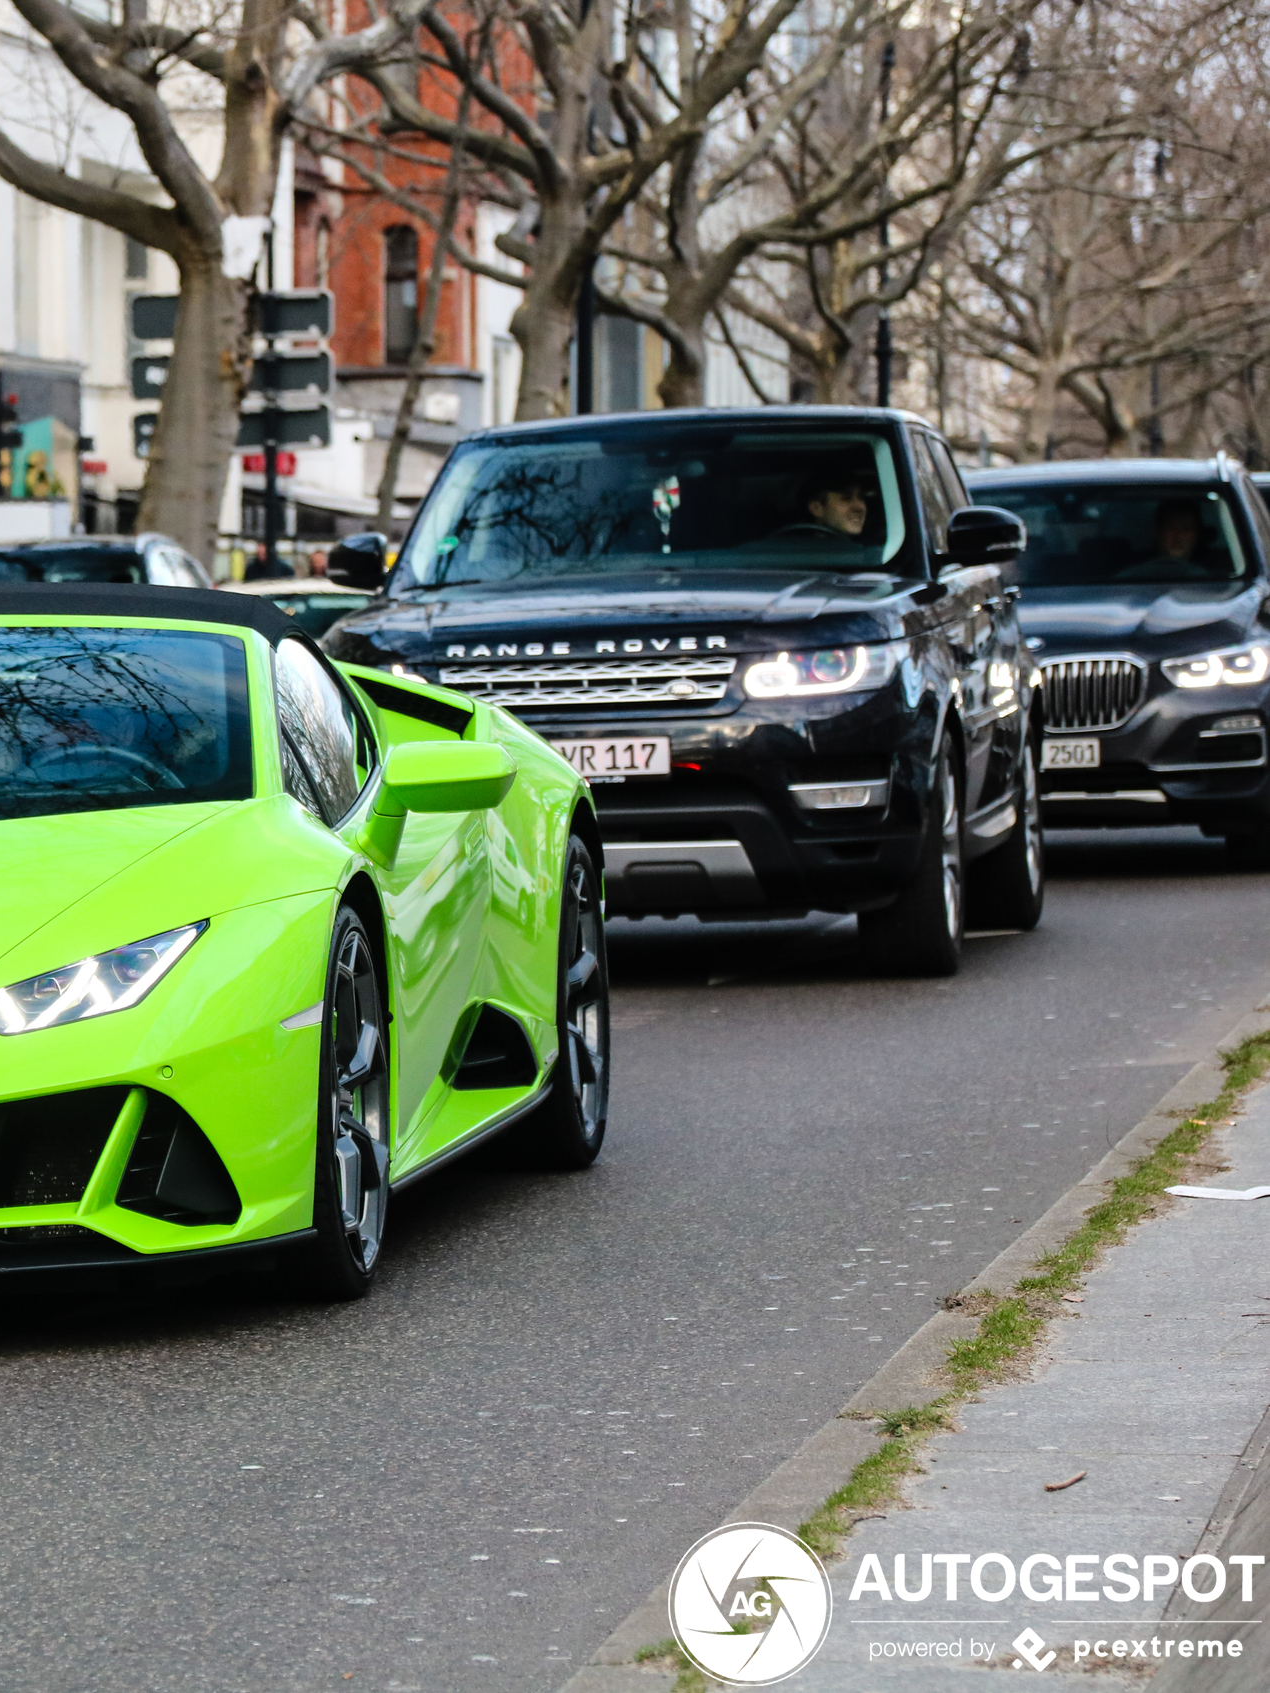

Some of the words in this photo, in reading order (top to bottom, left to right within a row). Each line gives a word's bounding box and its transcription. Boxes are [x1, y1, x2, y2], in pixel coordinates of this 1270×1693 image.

[446, 641, 571, 658] RANGE
[596, 635, 727, 654] ROVER
[605, 743, 657, 771] 117
[1049, 744, 1095, 764] 2501
